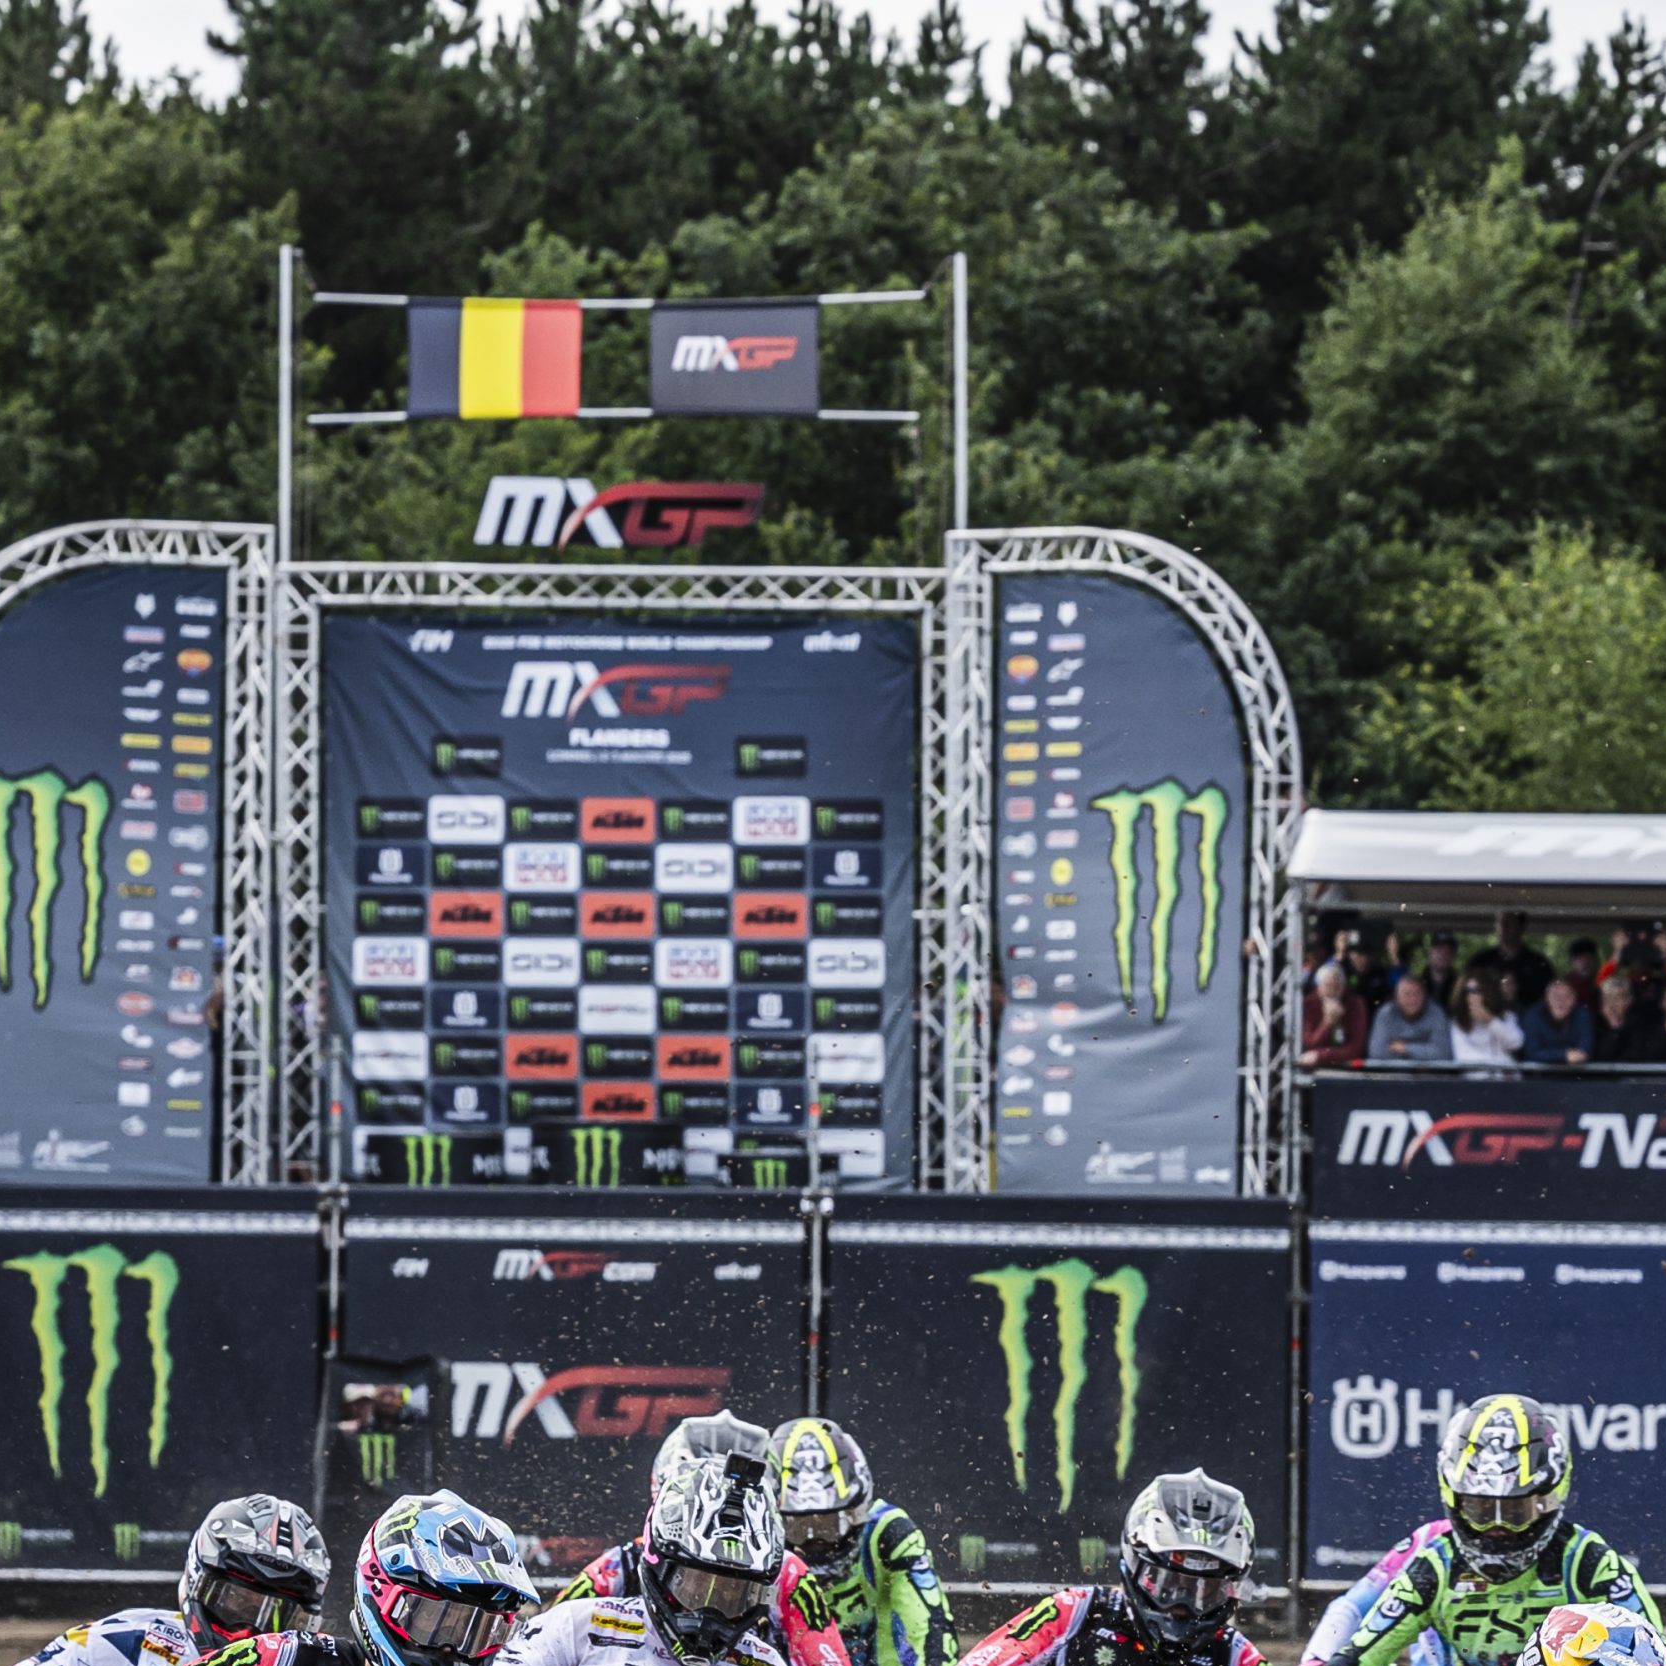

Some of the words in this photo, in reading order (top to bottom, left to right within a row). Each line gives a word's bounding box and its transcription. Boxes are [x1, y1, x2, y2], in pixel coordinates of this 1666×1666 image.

[671, 335, 798, 371] MXGP
[474, 475, 765, 552] MXGP
[502, 661, 733, 721] MXGP
